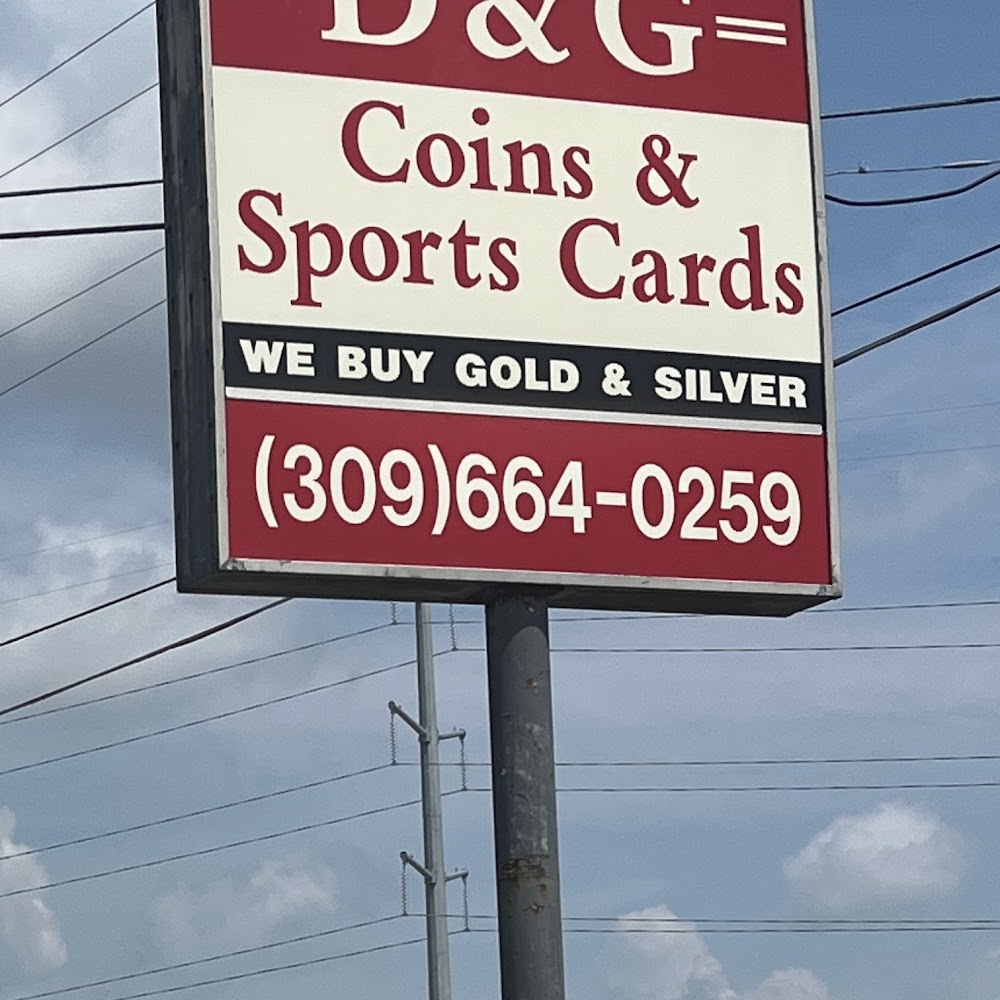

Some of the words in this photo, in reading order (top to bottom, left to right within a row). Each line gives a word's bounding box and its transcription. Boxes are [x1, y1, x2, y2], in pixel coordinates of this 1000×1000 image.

[342, 101, 593, 199] Coins
[636, 135, 698, 208] &
[238, 189, 520, 307] Sports
[560, 218, 805, 315] Cards
[239, 338, 315, 377] WE
[337, 345, 434, 384] BUY
[455, 353, 580, 393] GOLD
[601, 362, 632, 397] &
[654, 366, 807, 408] SILVER
[255, 434, 801, 546] (309)664-0259
